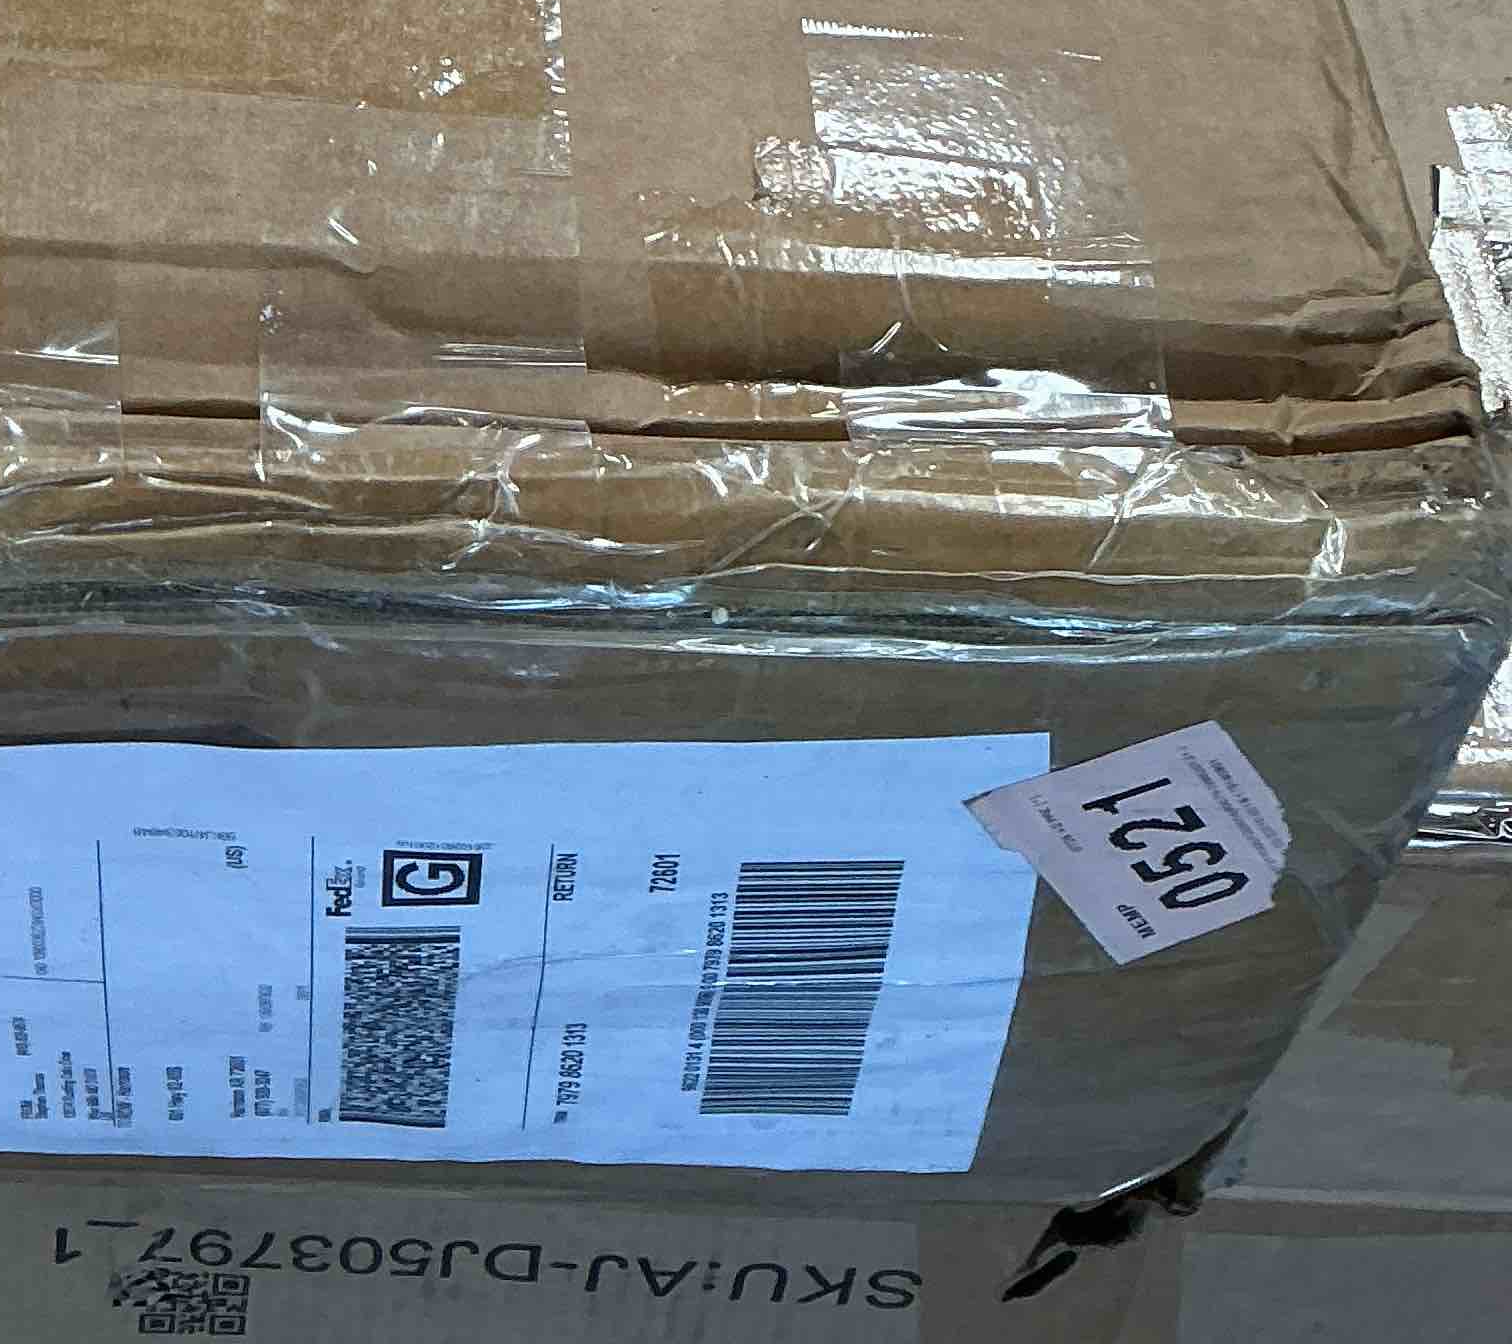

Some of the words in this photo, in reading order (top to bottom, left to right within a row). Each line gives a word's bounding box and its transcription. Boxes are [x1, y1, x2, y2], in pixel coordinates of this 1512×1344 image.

[224, 845, 249, 869] (US)
[1081, 776, 1250, 911] 0521
[394, 860, 466, 897] G
[550, 852, 579, 902] RETURN
[648, 853, 681, 894] 72601
[325, 865, 353, 917] FedEx
[706, 891, 729, 919] 1313
[702, 920, 727, 948] 8620
[1114, 902, 1157, 940] MEMP
[699, 948, 724, 972] 7979
[563, 1022, 588, 1048] 1313
[559, 1049, 586, 1079] 8620
[555, 1080, 581, 1106] 7979
[50, 1217, 924, 1311] SKU:AJ-DJ503797_1
